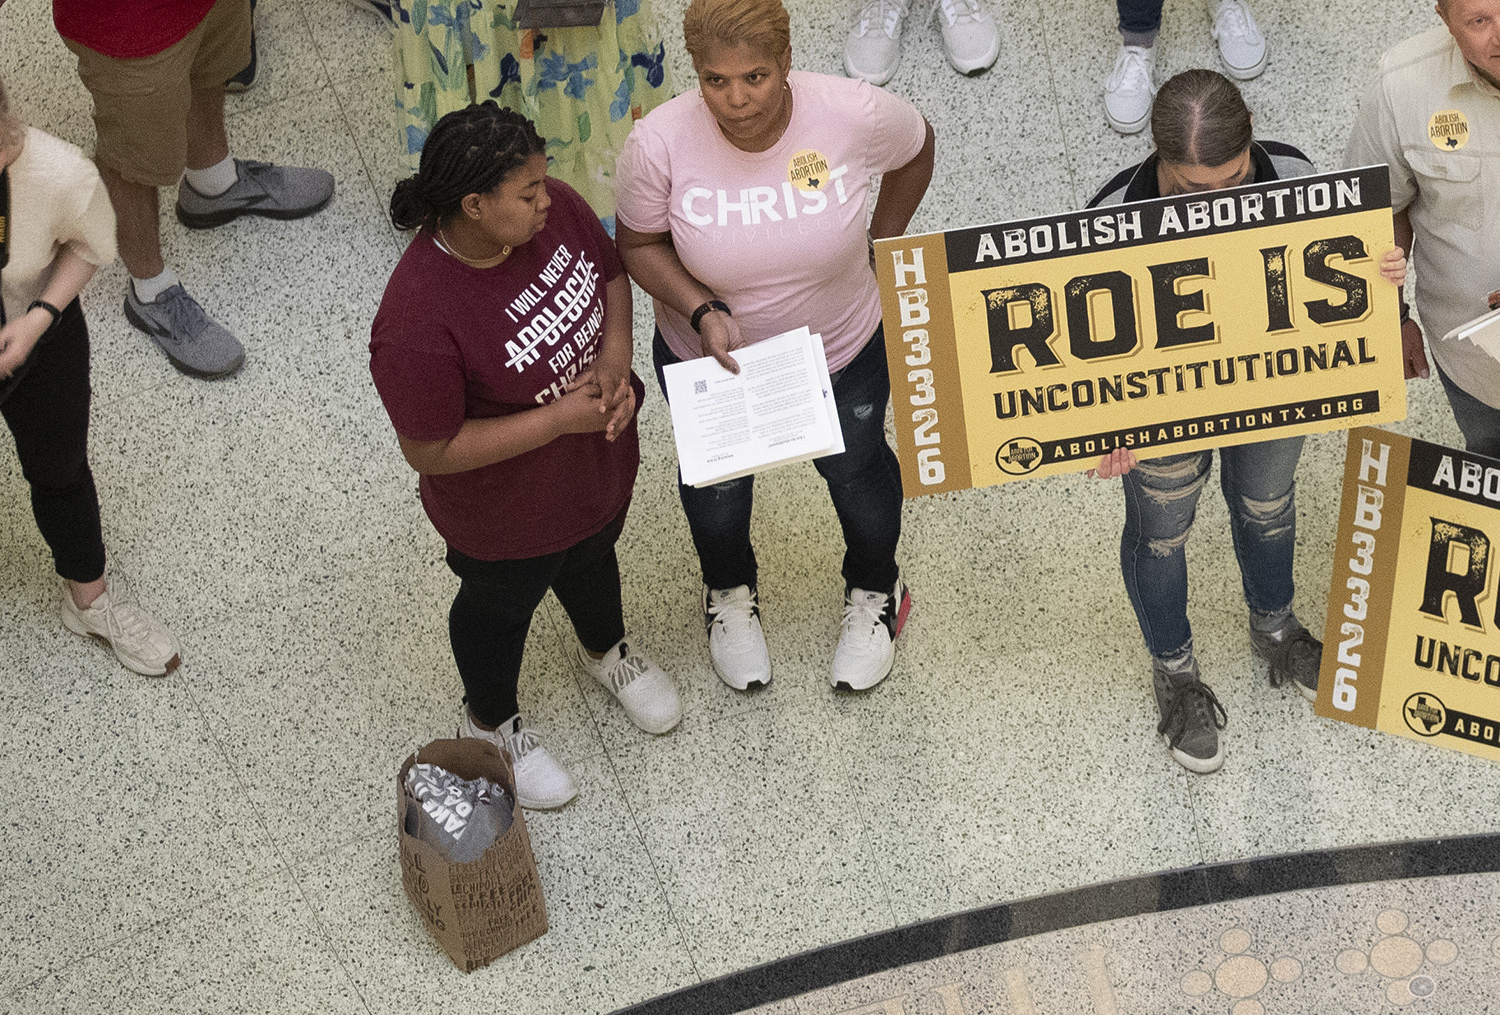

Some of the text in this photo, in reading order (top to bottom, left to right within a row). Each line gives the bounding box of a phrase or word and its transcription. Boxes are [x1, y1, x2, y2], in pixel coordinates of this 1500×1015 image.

[1430, 122, 1469, 138] ABORTION
[1435, 113, 1460, 124] ABOLISH
[681, 164, 849, 227] CHRIST
[790, 159, 829, 183] ABORTION
[792, 152, 818, 168] ABOLISH
[975, 177, 1362, 264] ABOLISH ABORTION
[505, 244, 573, 323] I WILL NEVER
[980, 234, 1372, 376] ROE IS
[548, 343, 576, 374] FOR
[891, 246, 947, 487] HB3326
[994, 337, 1377, 420] UNCONSTITUTIONAL
[1332, 439, 1392, 712] HB3326
